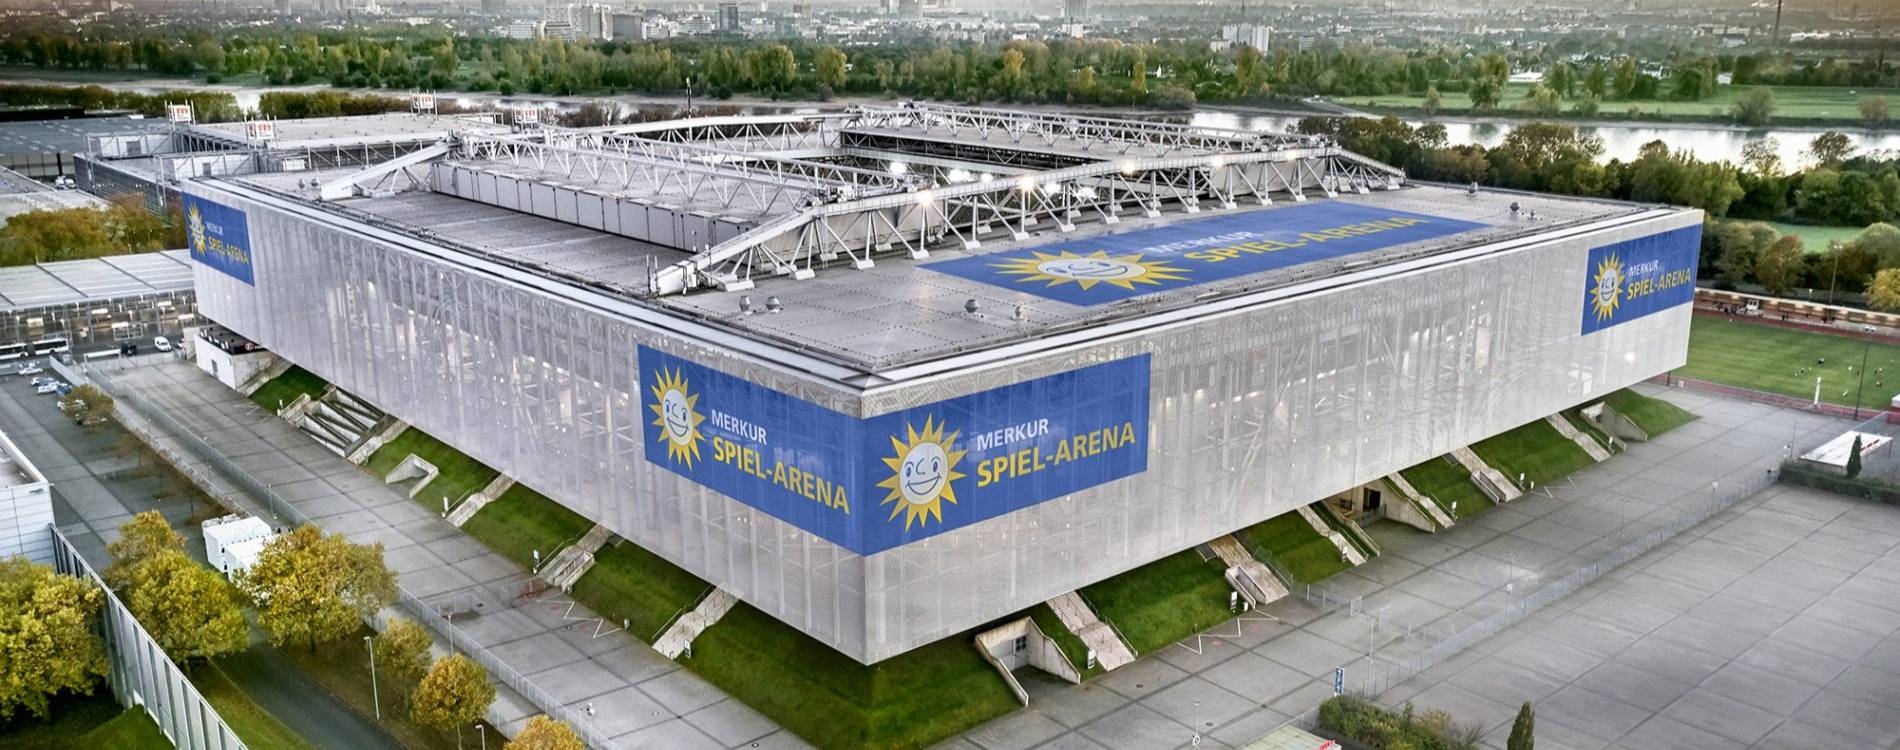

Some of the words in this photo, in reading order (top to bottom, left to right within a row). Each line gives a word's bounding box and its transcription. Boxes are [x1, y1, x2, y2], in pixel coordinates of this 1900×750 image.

[208, 236, 248, 265] SPIEL-ARENA
[1144, 231, 1265, 254] MERKUR
[1183, 217, 1431, 262] SPIEL-ARENA
[1627, 268, 1691, 300] SPIEL-ARENA
[1630, 260, 1658, 276] MERKUR
[711, 409, 767, 446] MERKUR
[977, 418, 1049, 451] MERKUR
[976, 422, 1135, 487] SPIEL-ARENA
[713, 436, 850, 514] SPIEL-ARENA
